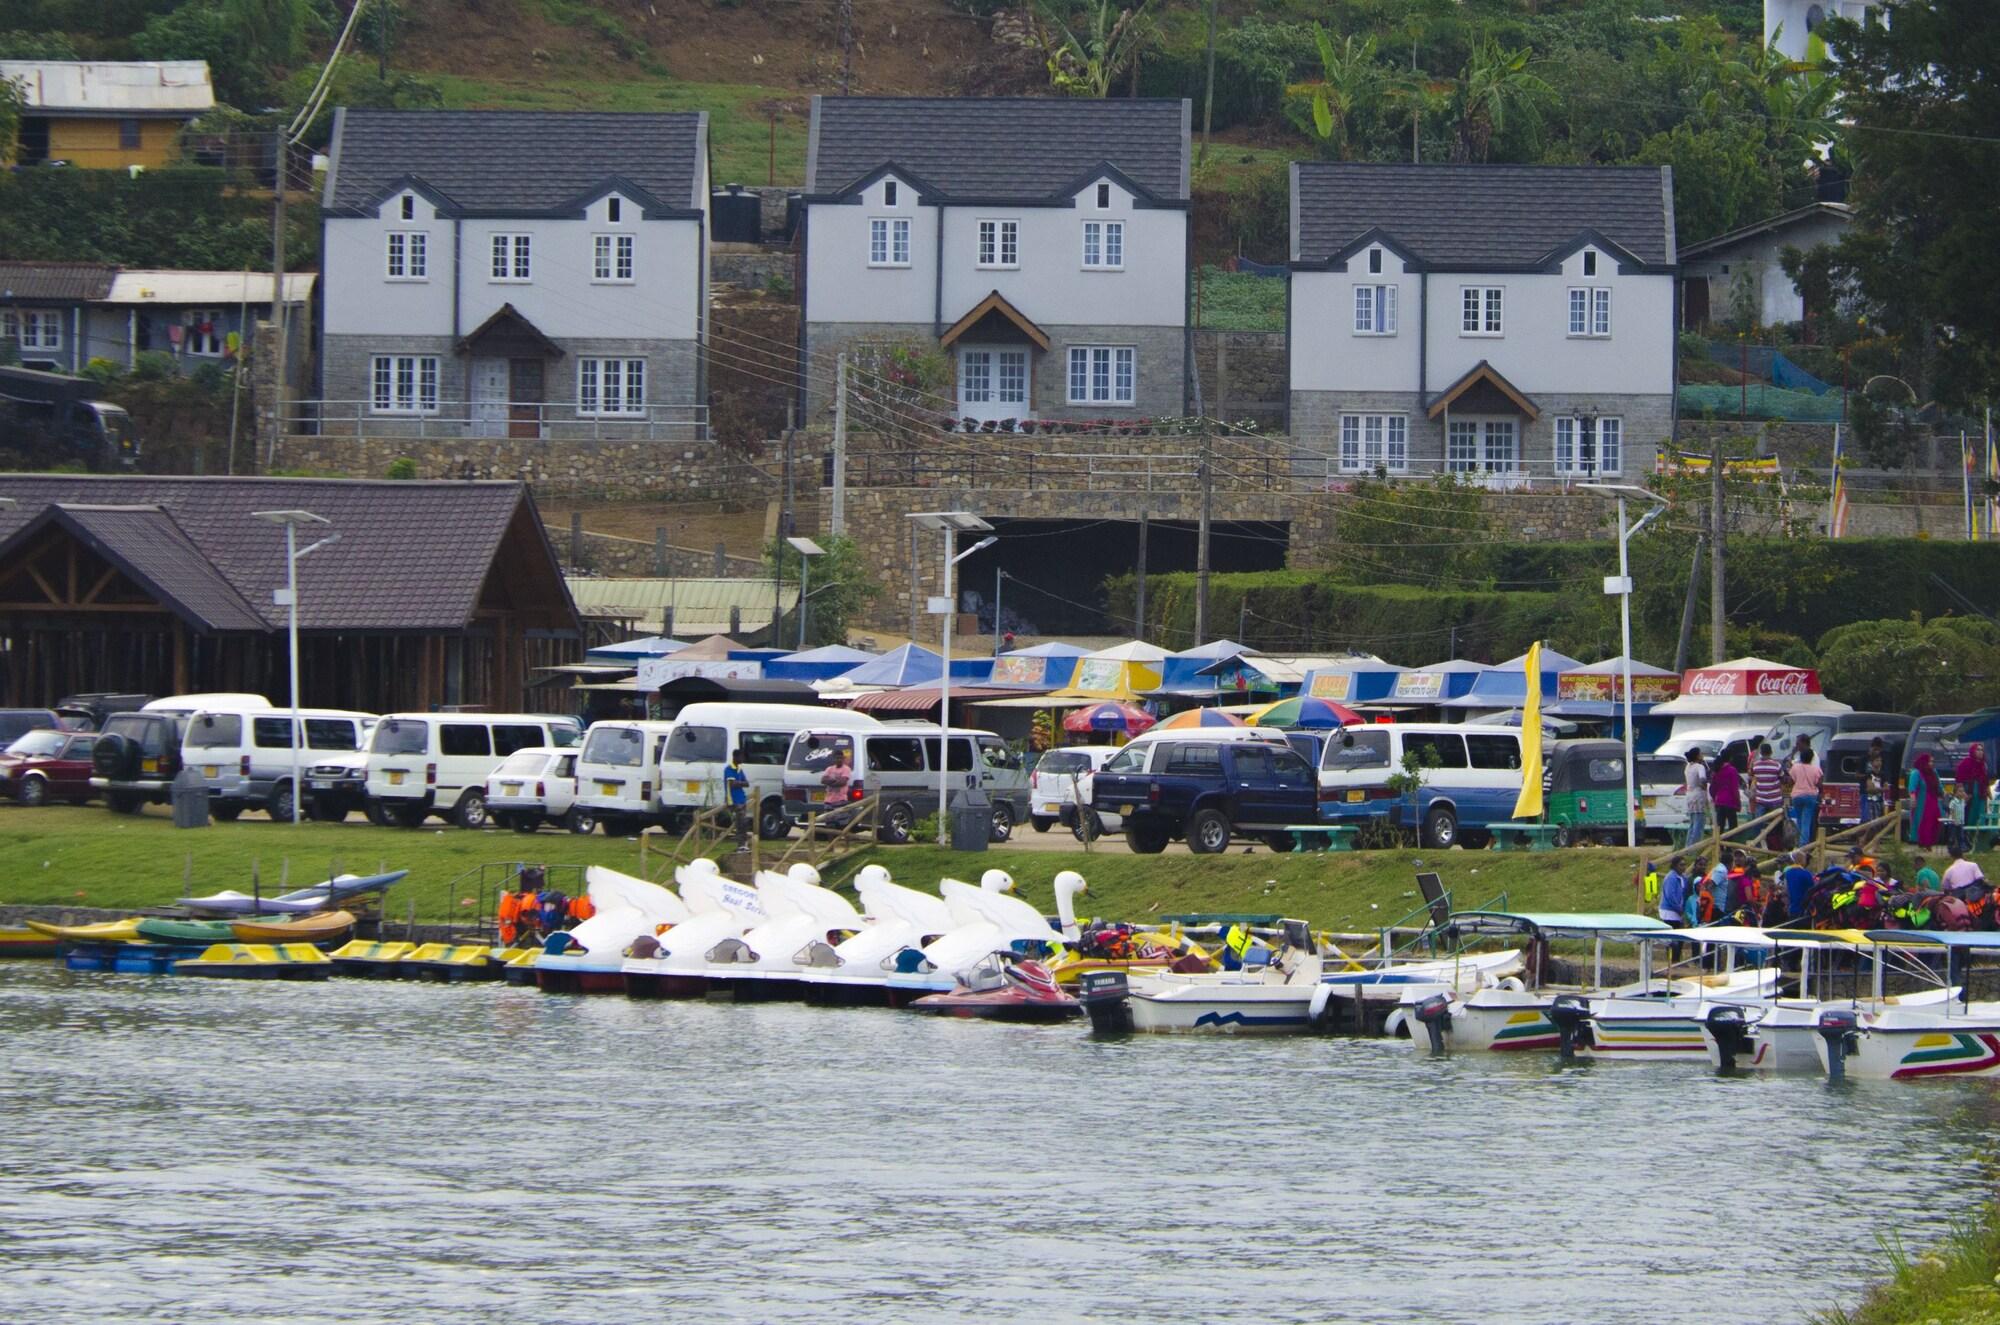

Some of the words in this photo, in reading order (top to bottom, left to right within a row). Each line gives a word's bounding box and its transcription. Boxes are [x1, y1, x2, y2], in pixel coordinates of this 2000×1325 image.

[1689, 672, 1739, 696] Coca-Cola
[1756, 672, 1808, 695] Coca-Cola
[1094, 977, 1115, 986] YAMAHA
